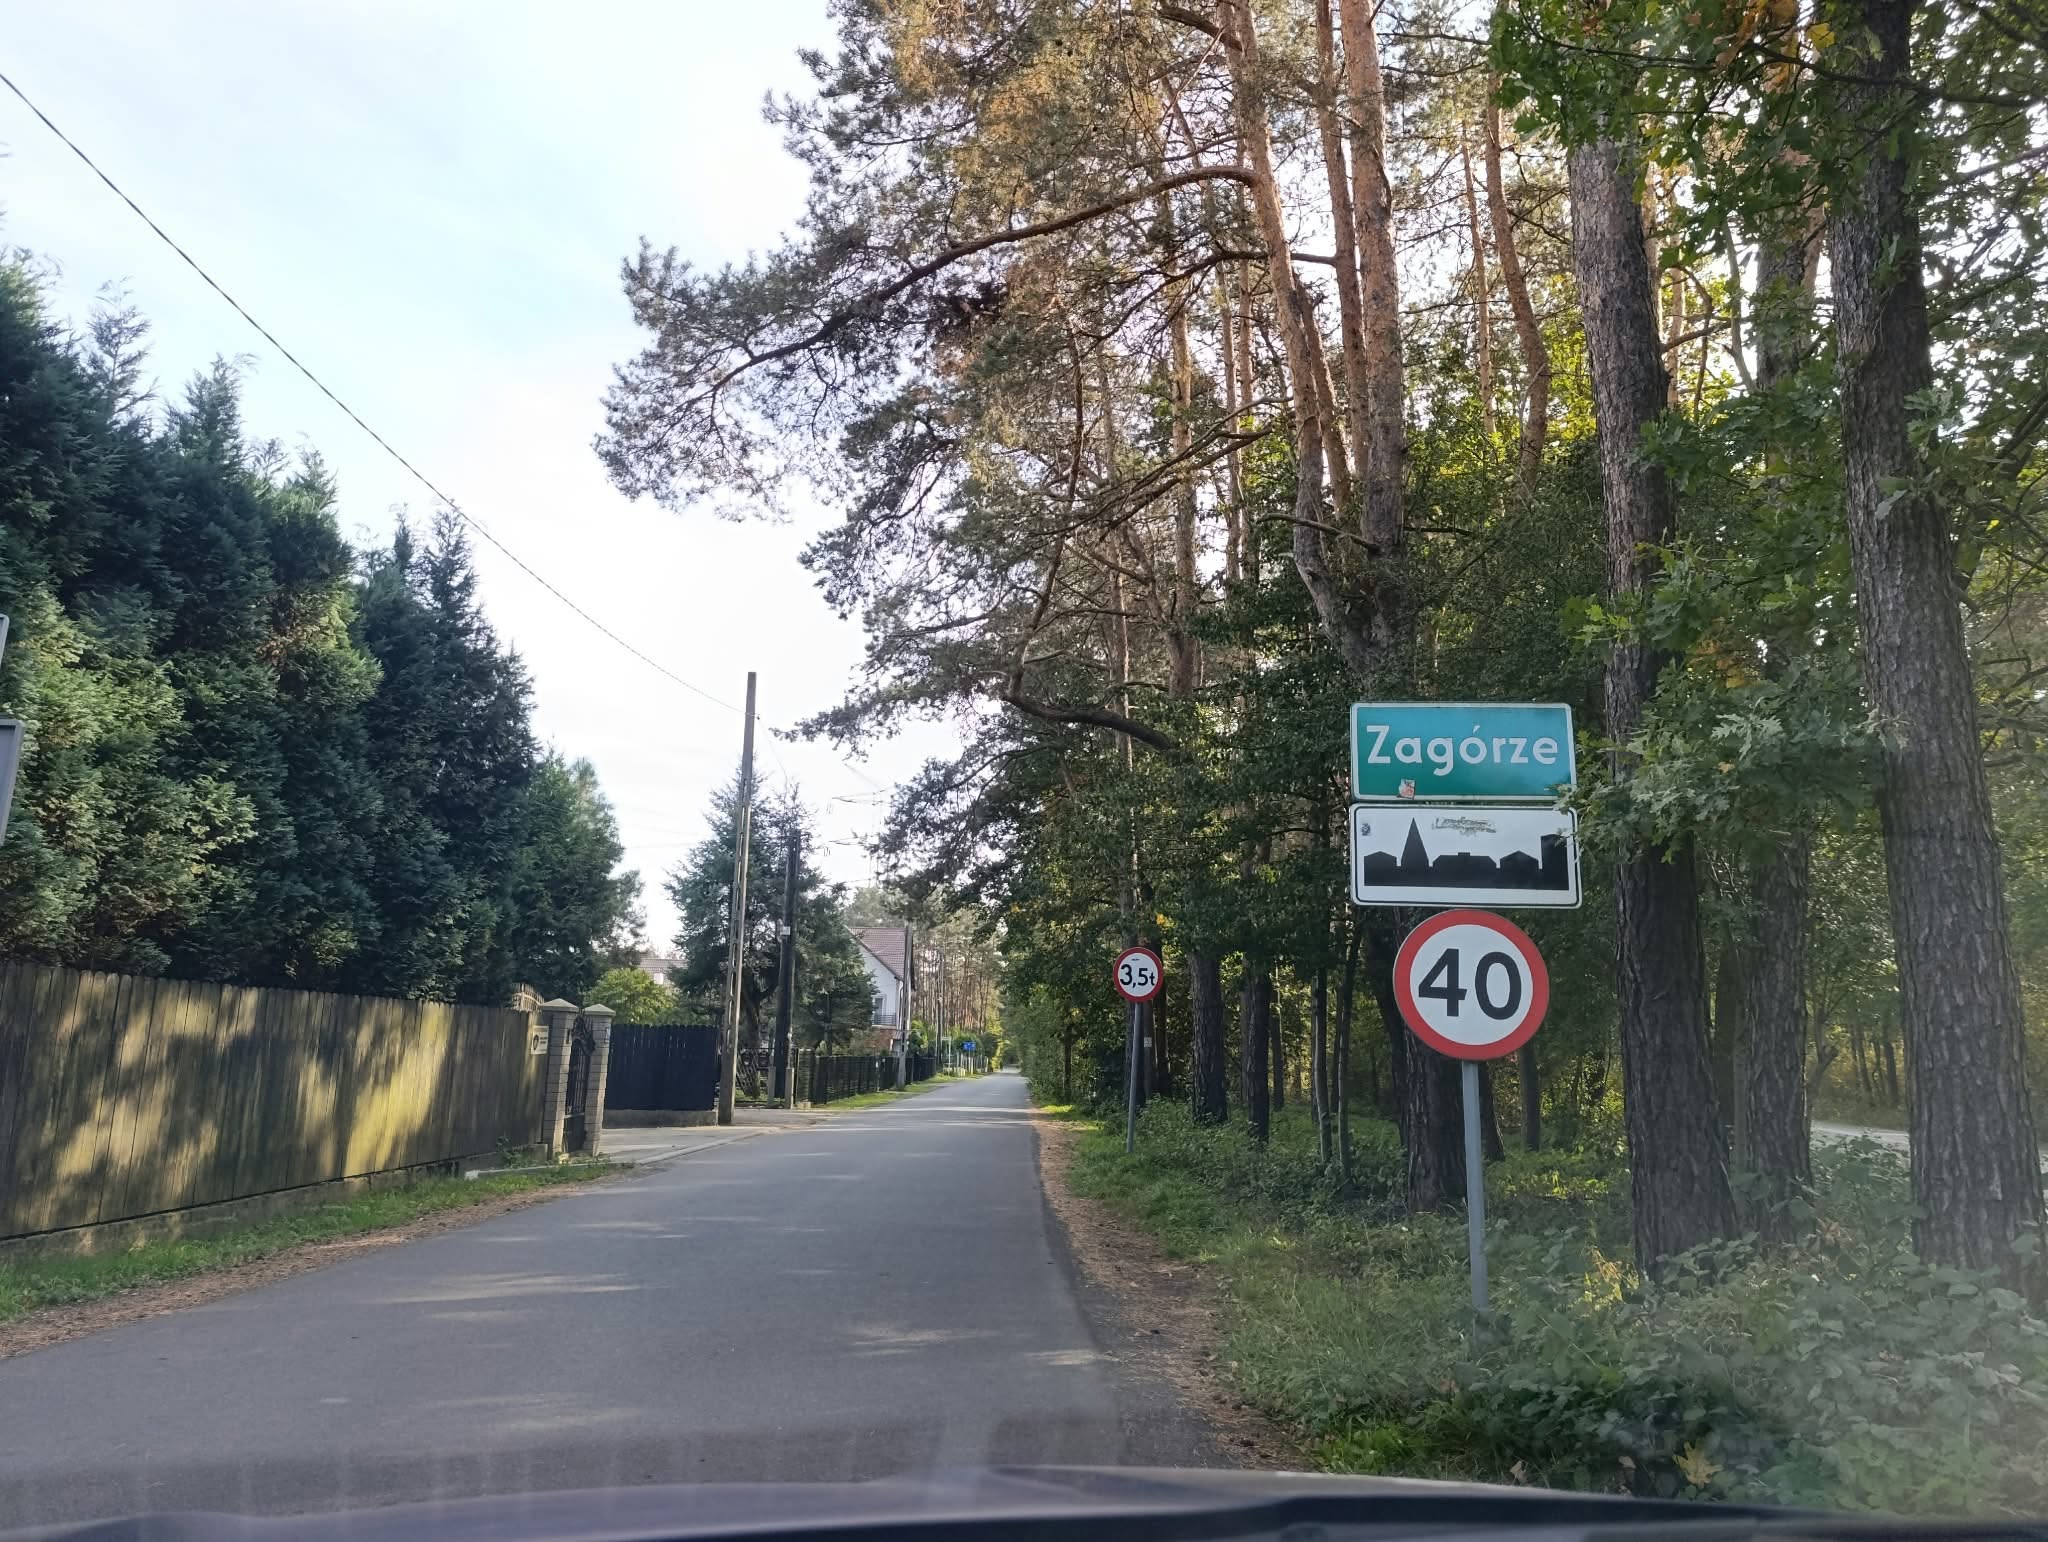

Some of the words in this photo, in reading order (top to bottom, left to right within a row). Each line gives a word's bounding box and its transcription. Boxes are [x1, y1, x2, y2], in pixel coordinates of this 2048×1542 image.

[1366, 725, 1559, 777] Zagórze
[1119, 963, 1156, 988] 3,5t
[1418, 948, 1522, 1021] 40
